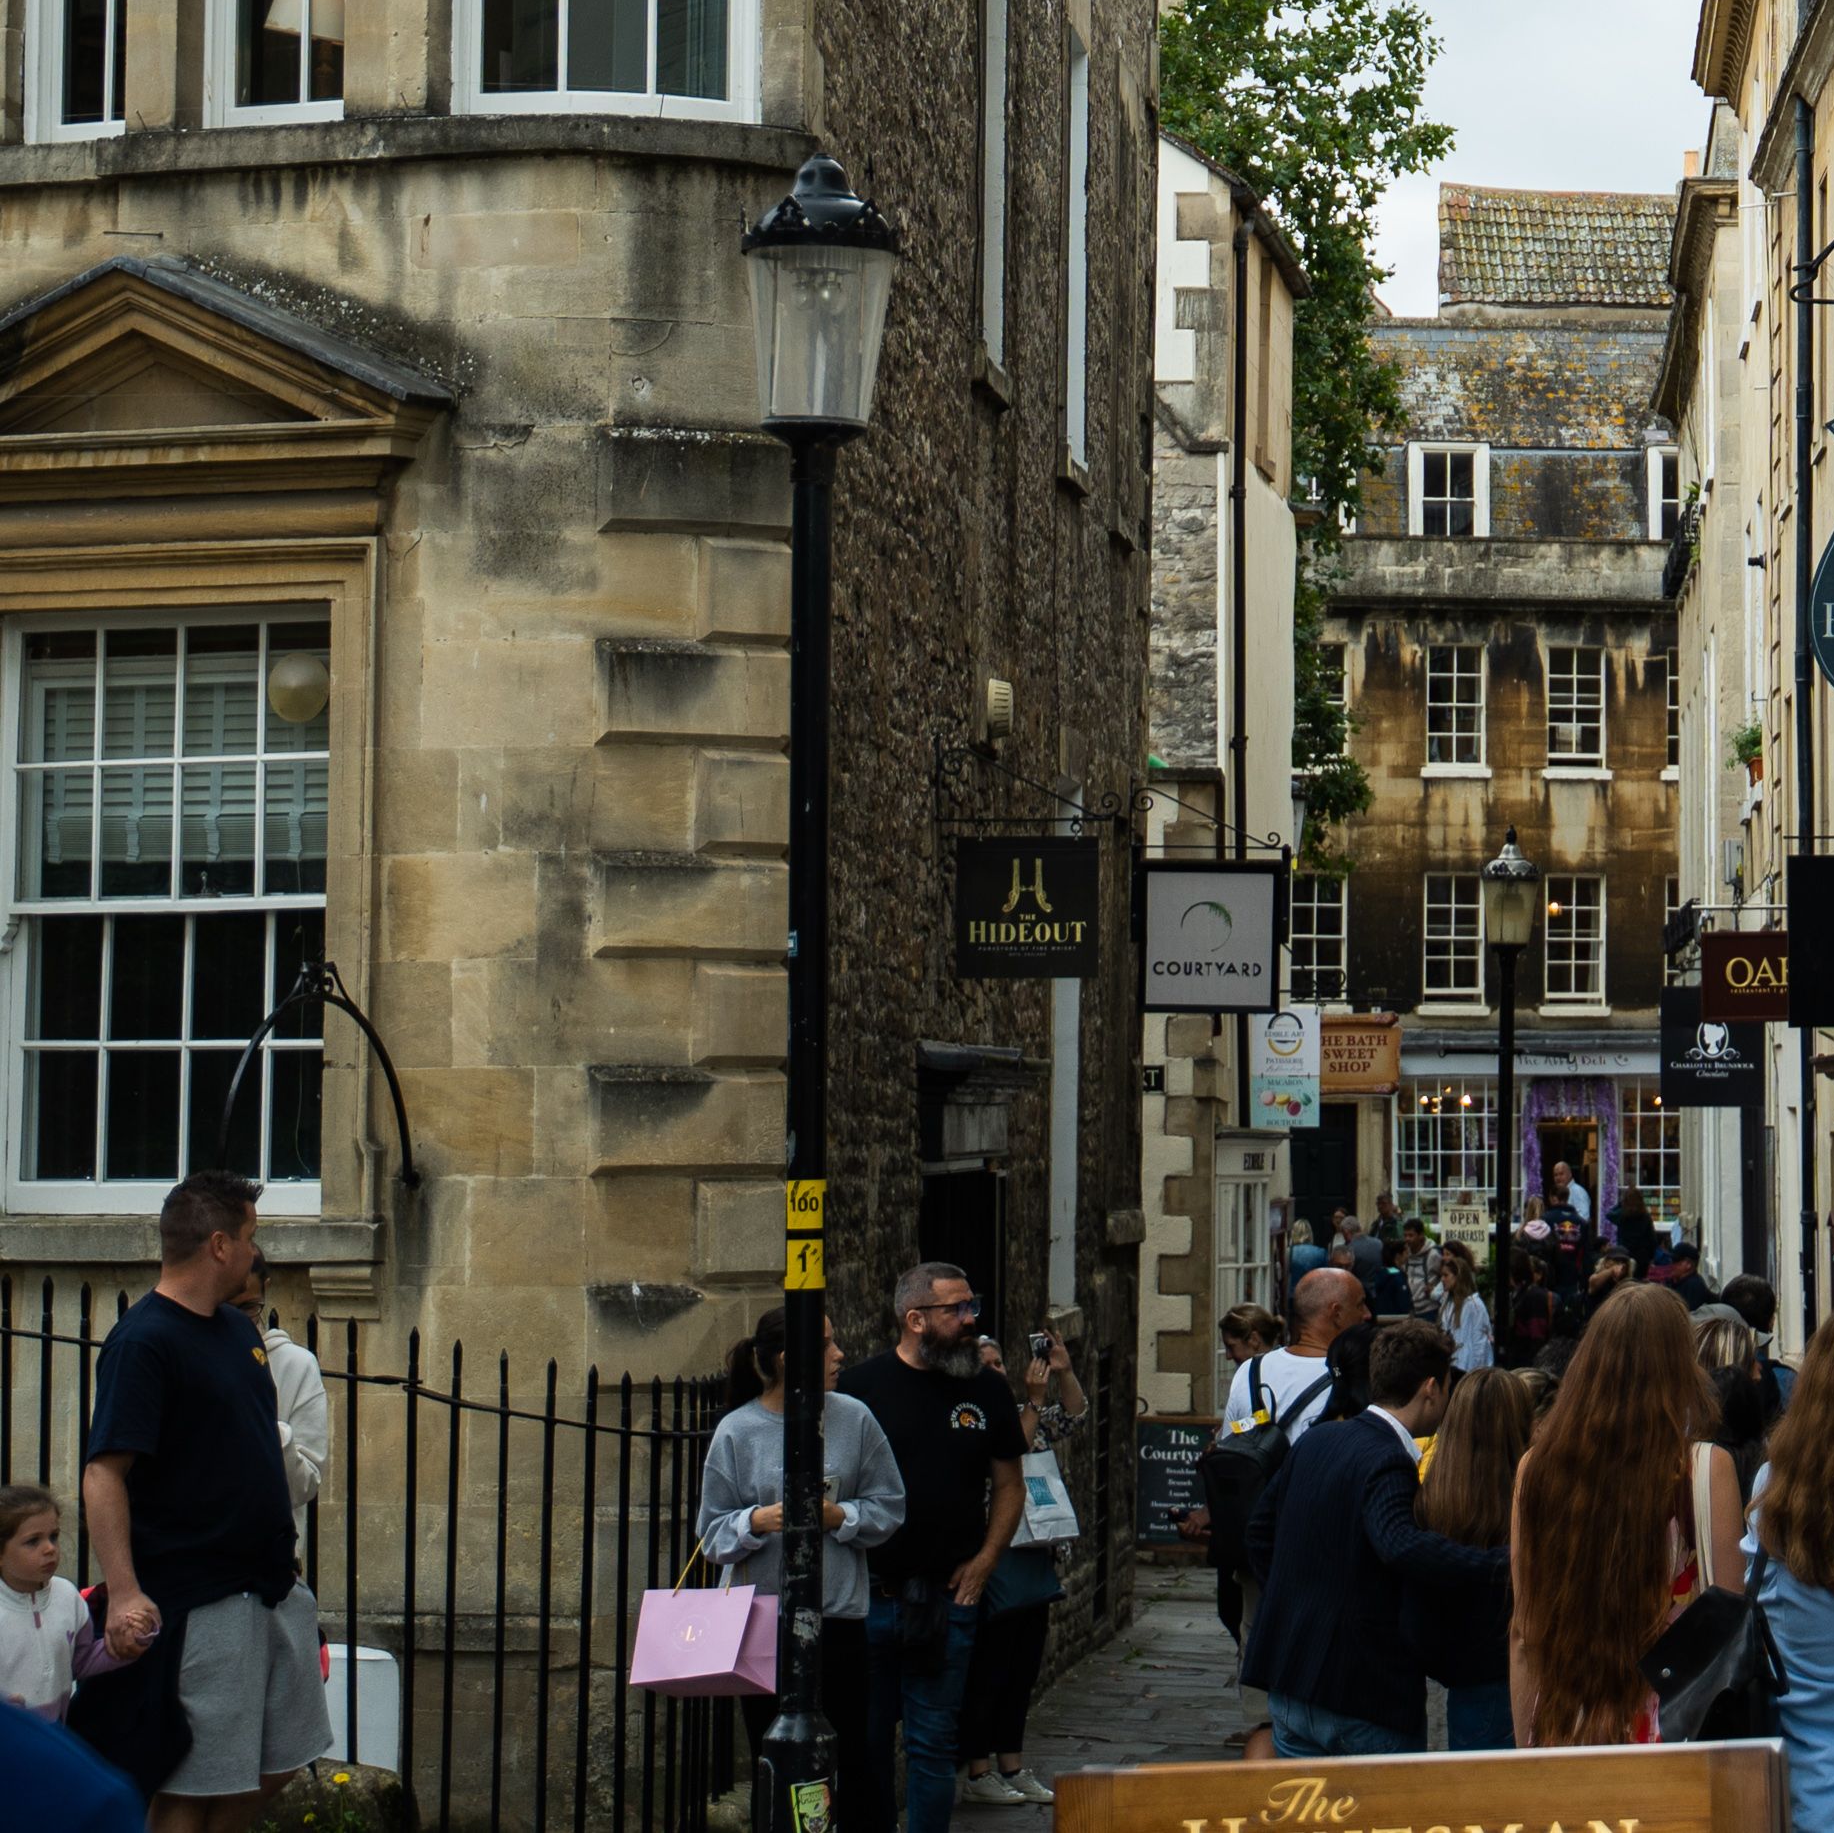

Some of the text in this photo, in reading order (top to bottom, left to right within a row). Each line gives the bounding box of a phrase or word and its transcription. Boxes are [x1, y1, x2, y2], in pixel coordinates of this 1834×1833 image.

[1019, 913, 1037, 921] THE
[968, 920, 1088, 943] HIDEOUT
[1152, 960, 1263, 978] COURTYARD
[1320, 1034, 1388, 1047] HE BATH
[1323, 1047, 1378, 1060] SWEET
[1328, 1061, 1372, 1073] SHOP
[1670, 1061, 1755, 1069] CHARLOTTE BRUNSWICK
[790, 1196, 819, 1212] 100
[1450, 1212, 1480, 1225] OPEN
[1168, 1429, 1200, 1445] The
[1259, 1776, 1360, 1824] The
